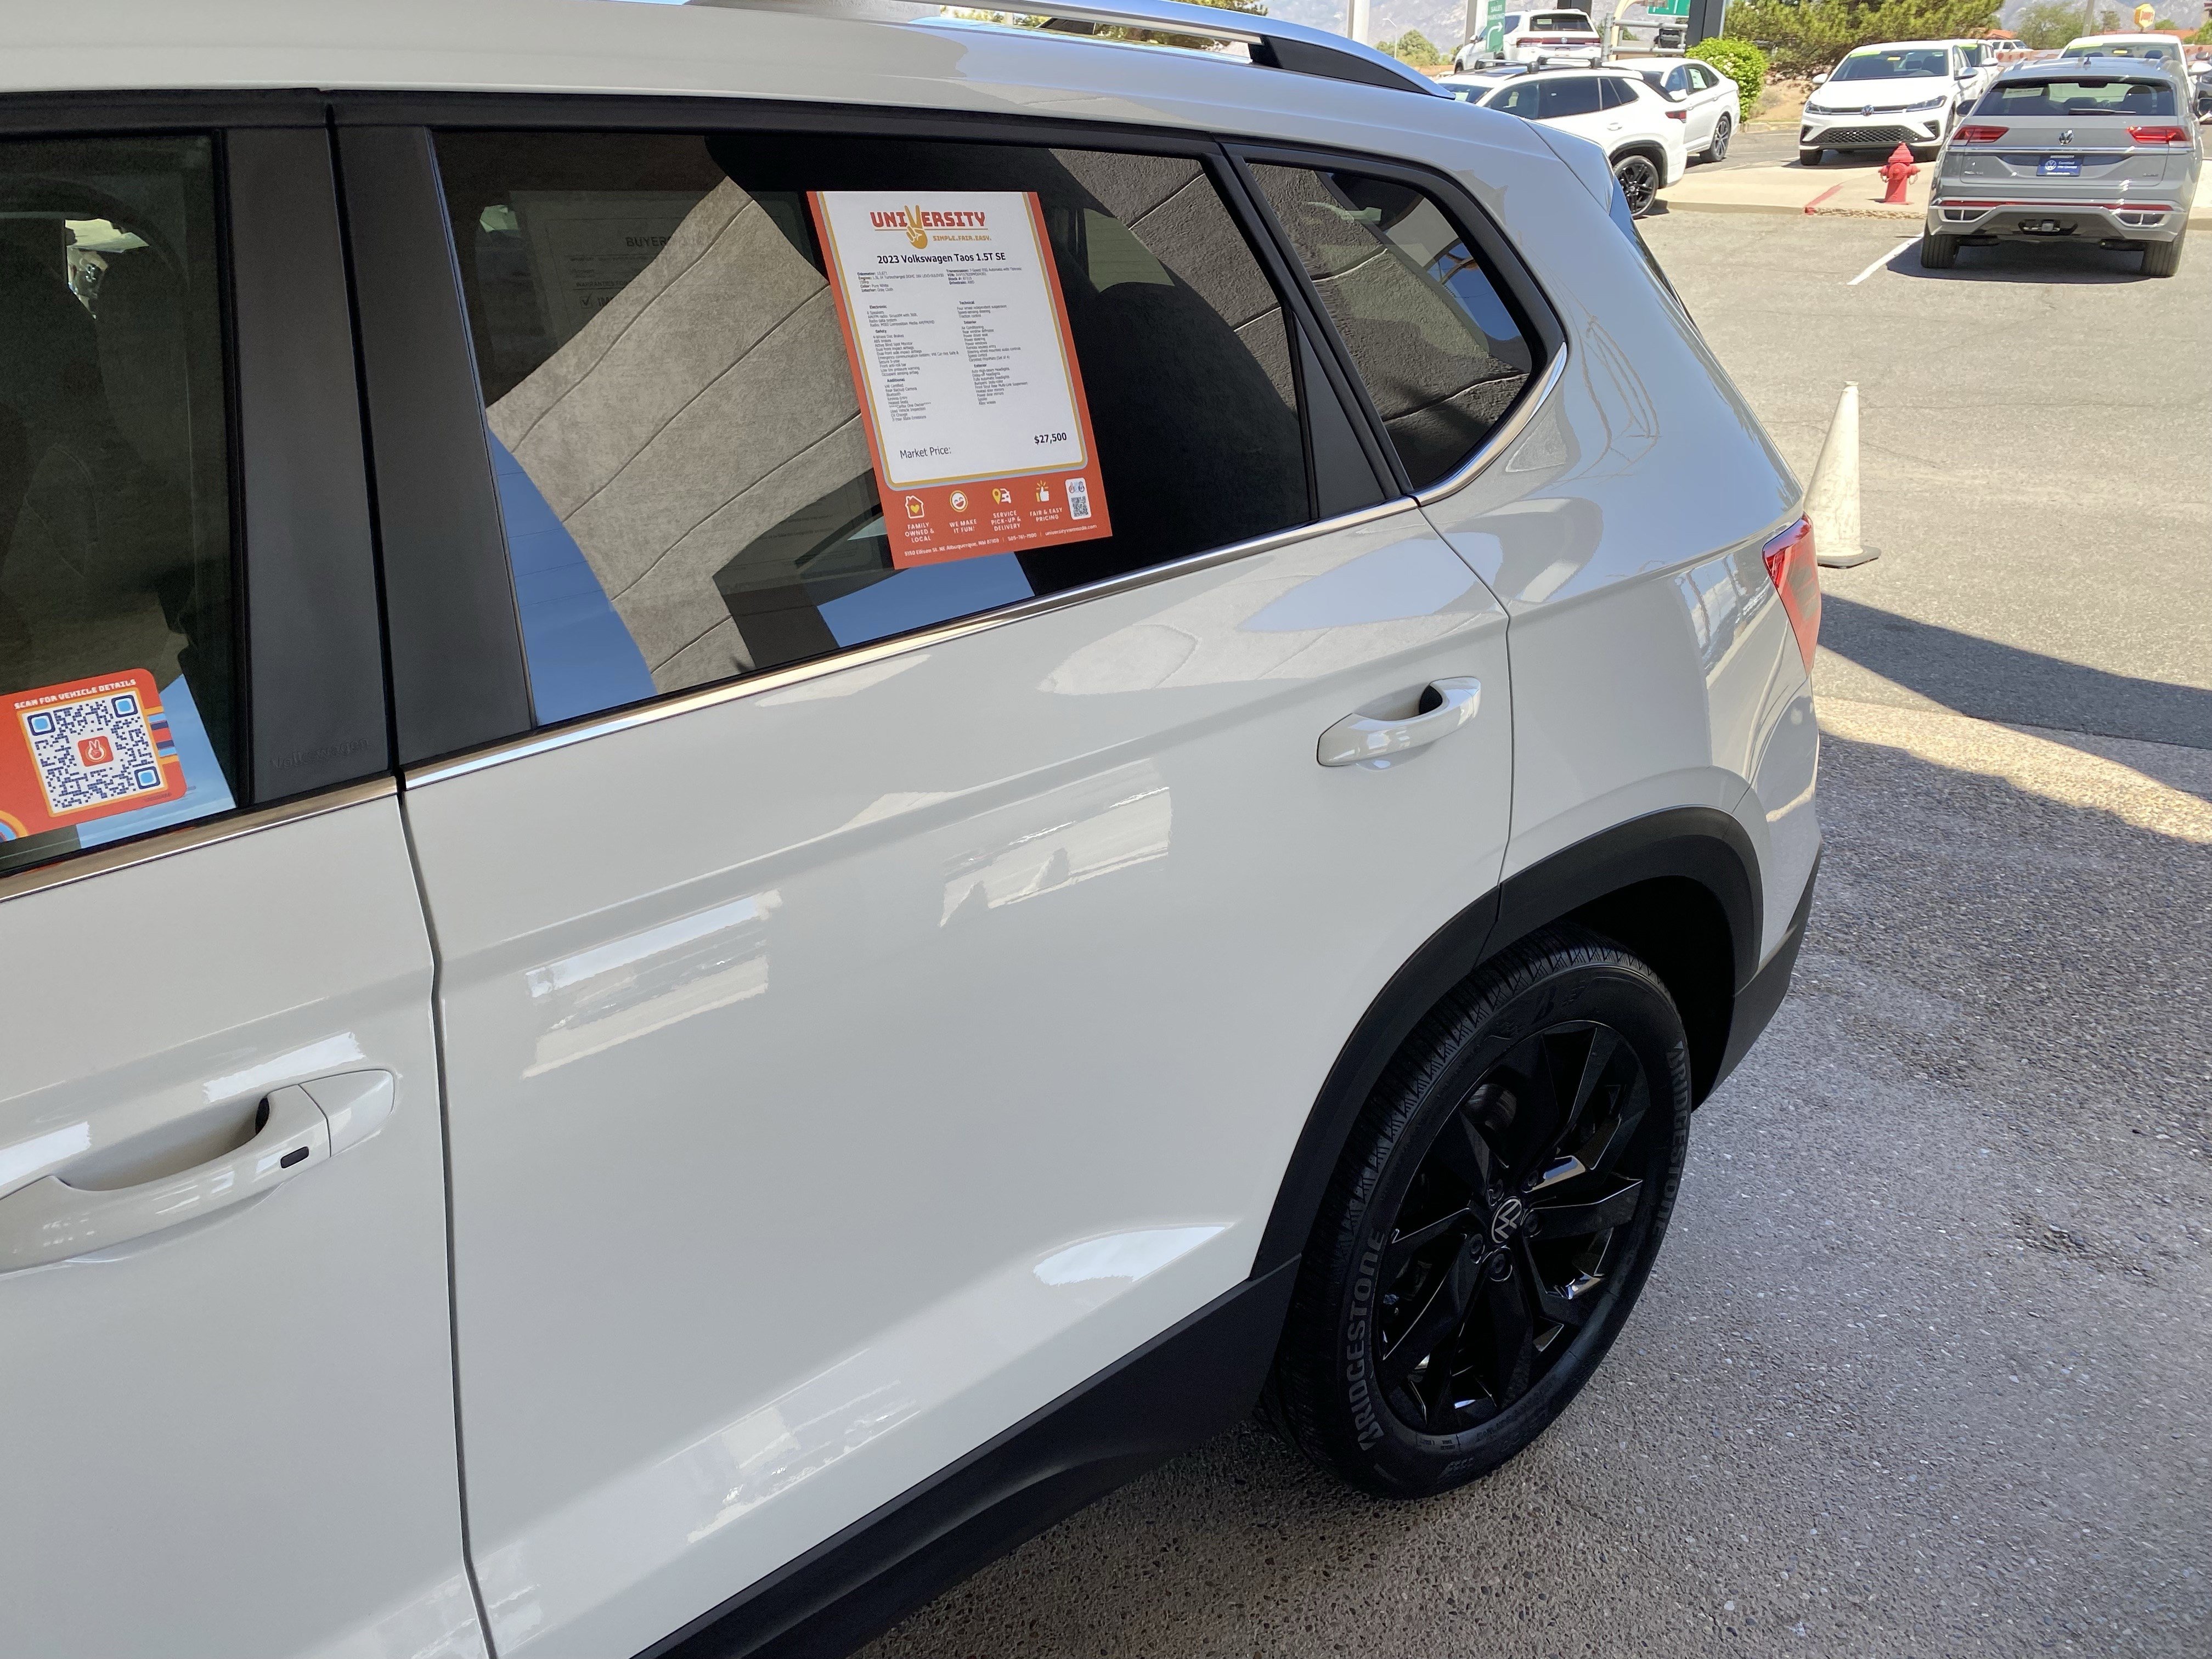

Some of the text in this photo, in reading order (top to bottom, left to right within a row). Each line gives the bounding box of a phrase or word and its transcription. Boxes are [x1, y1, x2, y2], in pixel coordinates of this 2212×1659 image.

[877, 255, 899, 263] 2023
[900, 253, 953, 264] Volkswagen
[953, 253, 974, 261] Taos
[1033, 432, 1068, 444] $27,500
[899, 445, 951, 459] Market Price:
[990, 517, 1015, 525] PICK-UP
[994, 523, 1020, 531] DELIVERY
[14, 679, 137, 709] SCAN FOR VEHICLE DETAILS
[270, 738, 370, 770] Volkswagen
[1346, 1229, 1387, 1453] BRIDGESTONE
